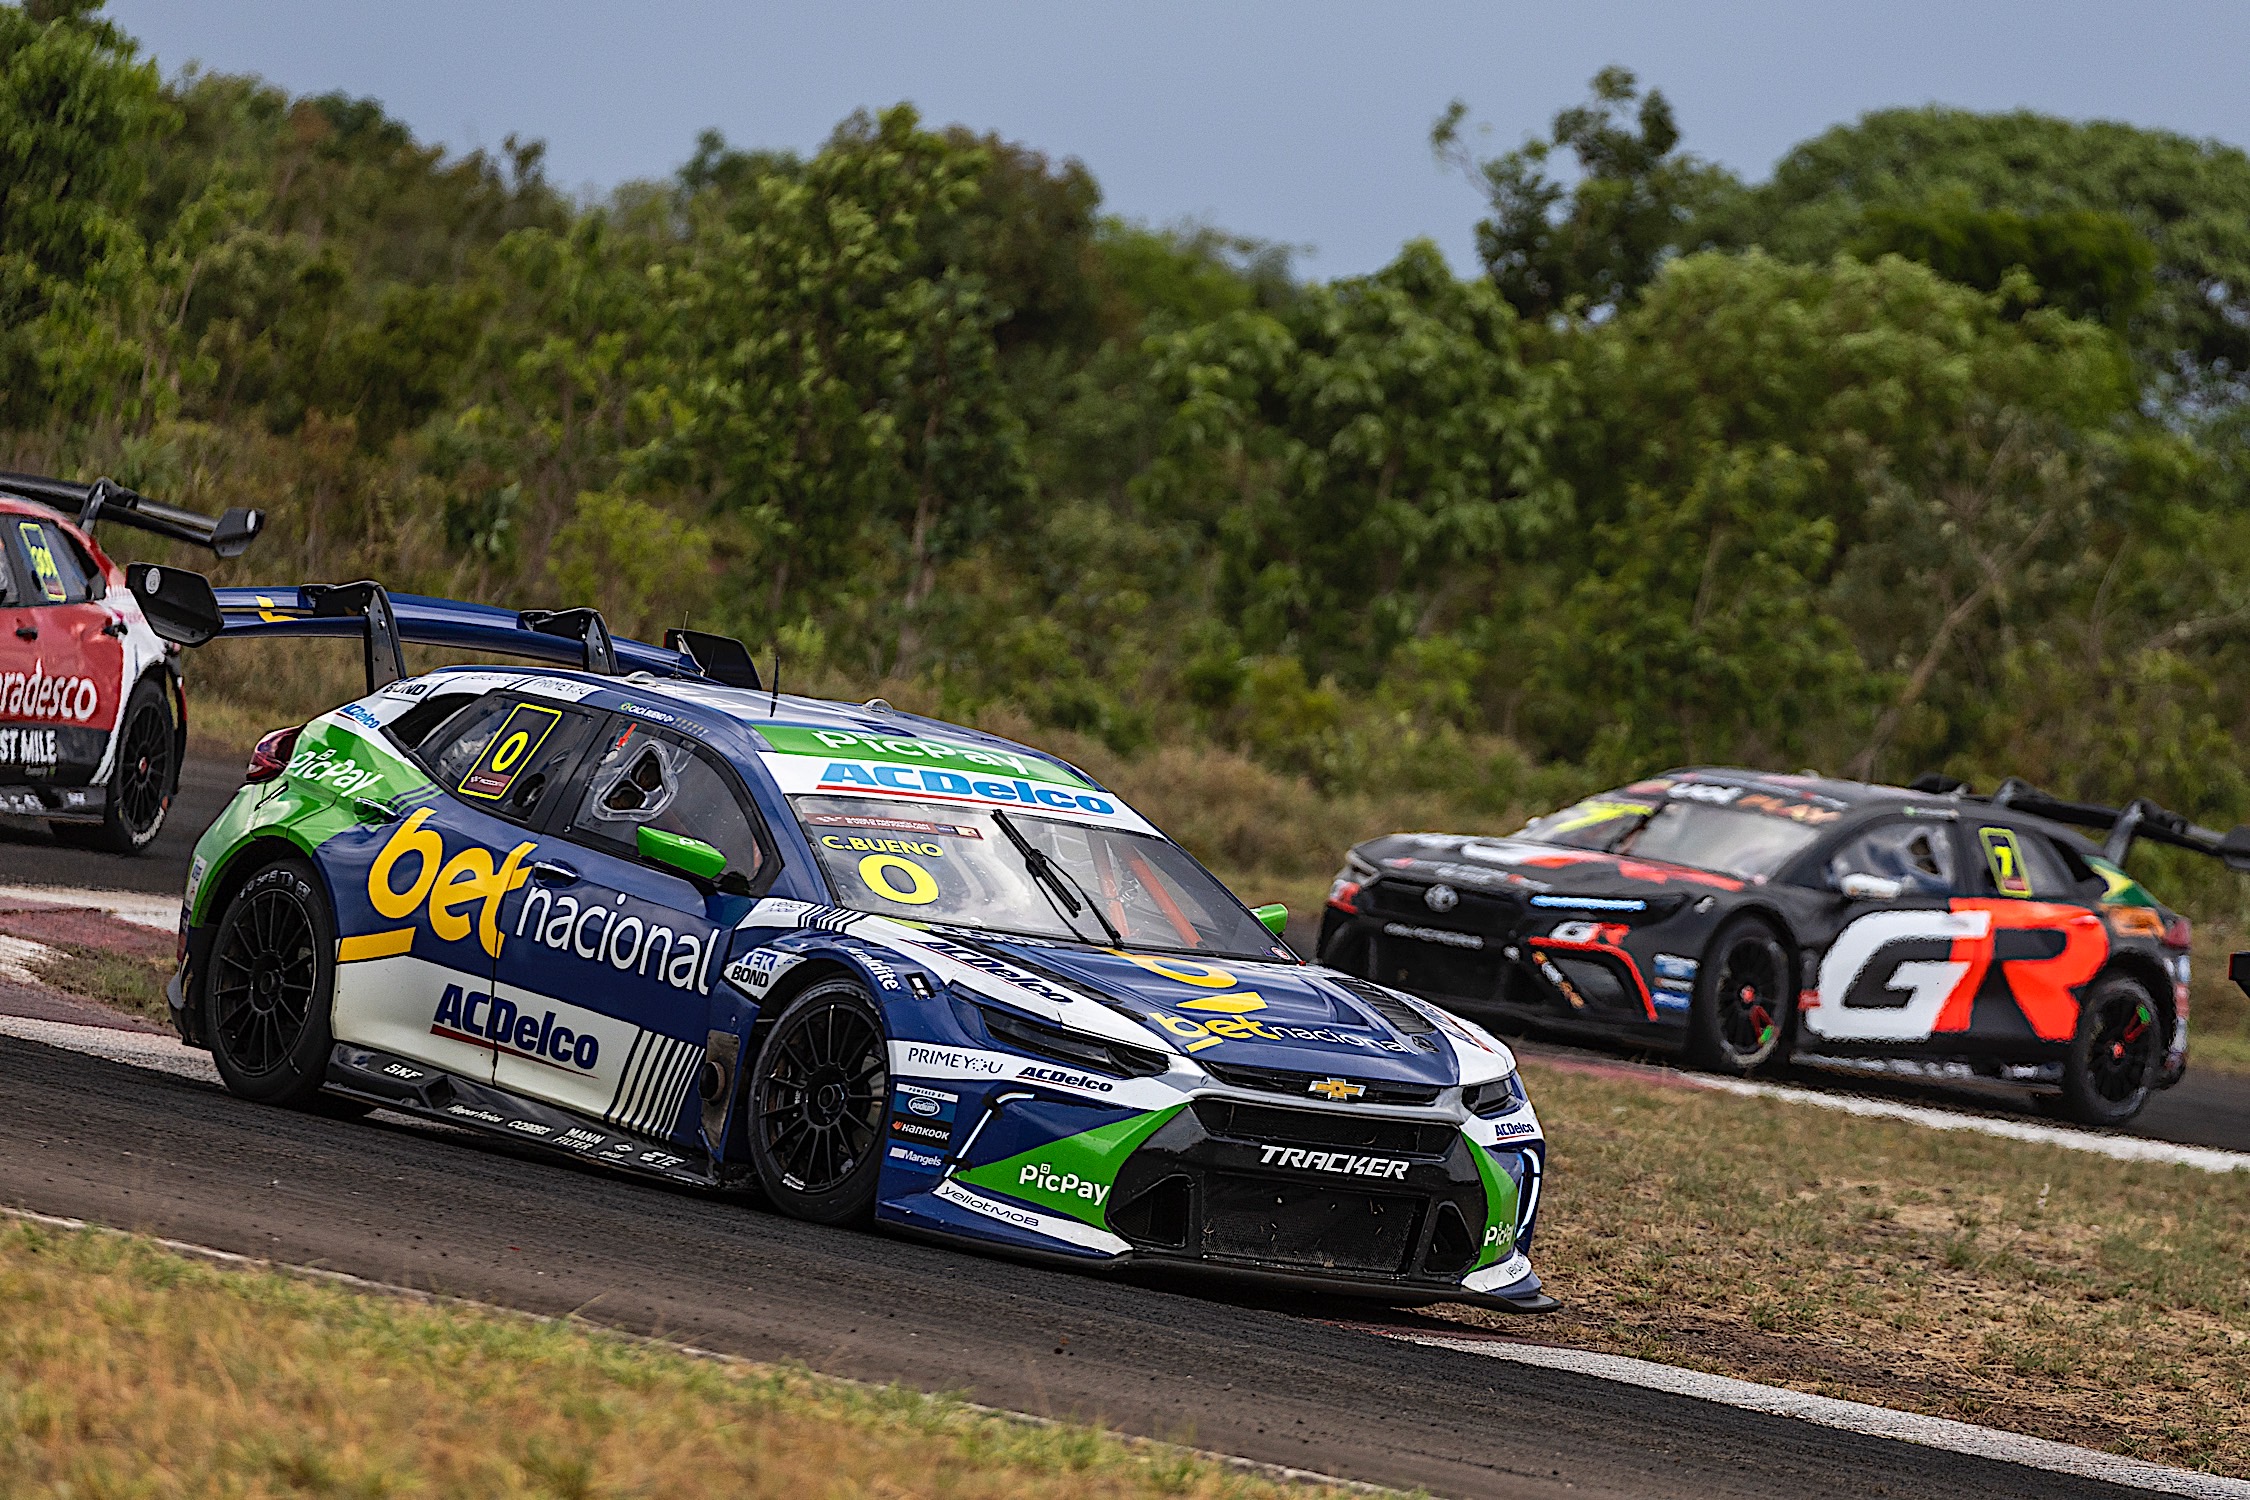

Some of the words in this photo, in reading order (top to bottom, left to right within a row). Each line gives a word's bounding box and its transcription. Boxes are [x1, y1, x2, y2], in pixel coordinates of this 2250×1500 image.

[0, 657, 98, 720] radesco
[341, 703, 380, 728] ACDelco
[21, 729, 57, 765] MILE
[812, 730, 1030, 775] PicPay
[281, 748, 385, 798] PicPay
[820, 763, 1115, 815] ACDelco
[821, 835, 944, 857] C.BUENO
[731, 965, 769, 987] BOND
[910, 940, 1074, 1003] ACDelco
[1804, 898, 2110, 1042] GR
[433, 982, 600, 1070] ACDelco
[384, 1063, 423, 1078] SKF
[1018, 1066, 1114, 1092] ACDelco
[908, 1086, 936, 1096] POWERED
[552, 1136, 593, 1151] FILTER
[566, 1127, 606, 1144] MANN
[1495, 1122, 1535, 1136] ACDelco
[903, 1150, 942, 1167] Mangels
[1260, 1144, 1410, 1180] TRACKER
[1019, 1163, 1110, 1206] PicPay
